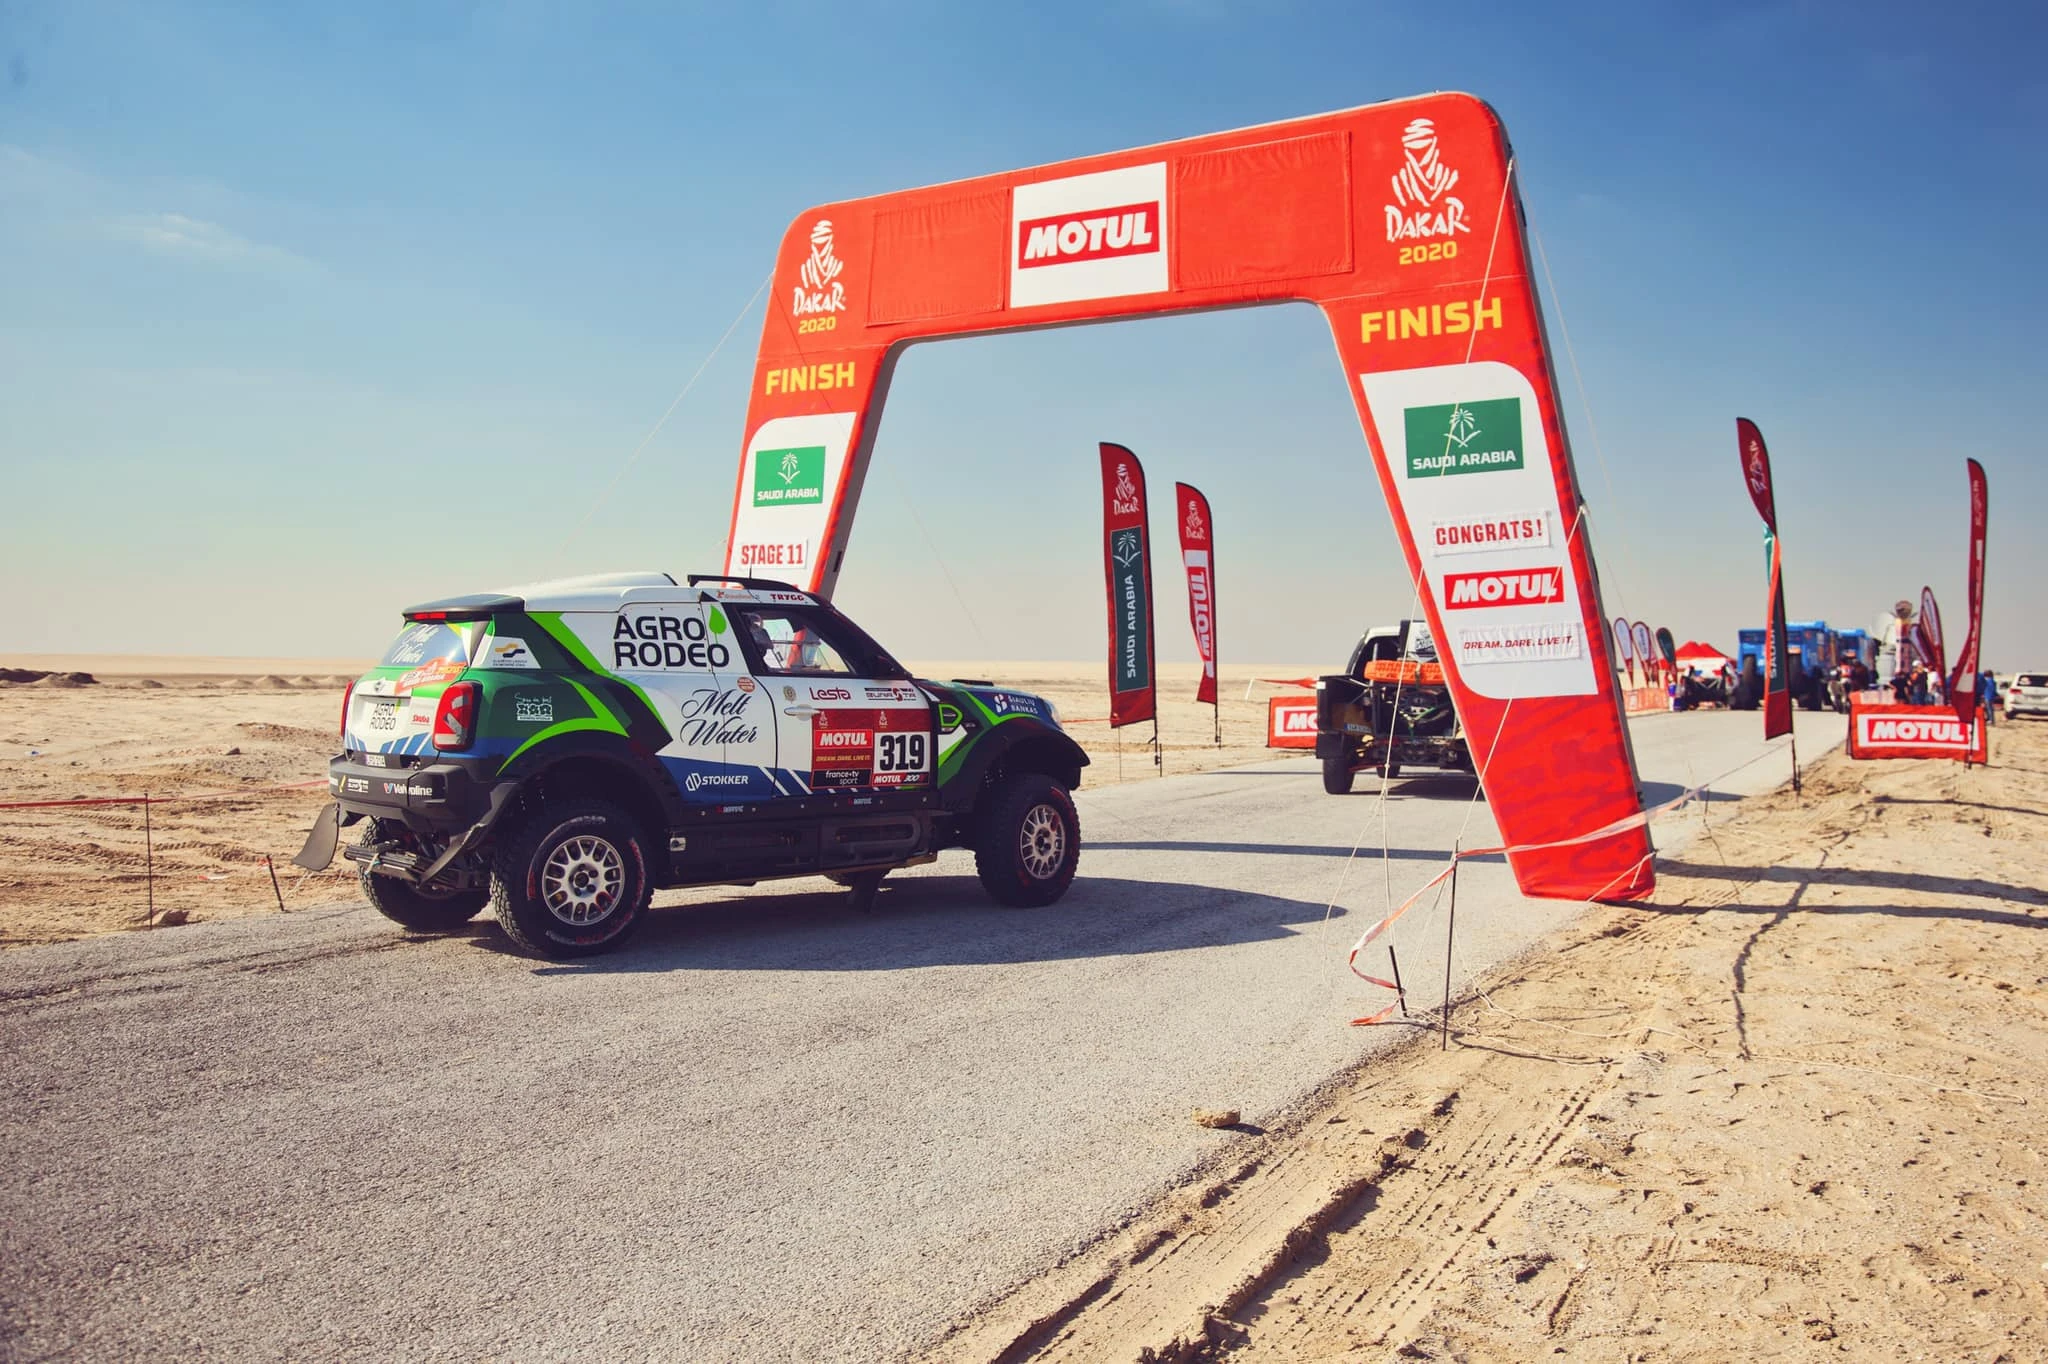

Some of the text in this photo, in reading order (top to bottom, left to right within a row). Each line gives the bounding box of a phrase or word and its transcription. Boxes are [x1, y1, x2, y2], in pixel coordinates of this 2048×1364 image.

[1384, 197, 1471, 242] DAKAR
[1024, 211, 1152, 260] MOTUL
[1399, 241, 1457, 265] 2020
[793, 282, 846, 316] DAKAR
[799, 316, 836, 334] 2020
[1361, 297, 1502, 344] FINISH
[765, 361, 855, 395] FINISH
[1412, 450, 1516, 470] SAUDI ARABIA
[757, 487, 819, 501] SAUDI ARABIA
[1113, 496, 1140, 515] DAKAR
[1435, 519, 1543, 546] CONGRATS!
[741, 543, 803, 565] STAGE 11
[1451, 573, 1558, 604] MOTUL
[1191, 571, 1210, 656] MOTUL
[613, 615, 706, 640] AGRO
[1125, 574, 1137, 679] SAUDI ARABIA
[615, 641, 730, 668] RODEO
[1464, 639, 1503, 650] DREAM.
[1504, 638, 1535, 648] DARE.
[1537, 636, 1562, 646] LIVE
[681, 688, 752, 719] Melt
[809, 687, 851, 700] Lesta
[369, 717, 397, 731] RODEO
[680, 716, 757, 746] Water
[1872, 721, 1965, 742] MOTUL
[820, 732, 867, 746] MOTUL
[879, 735, 925, 771] 319
[394, 783, 433, 796] Valvoline
[701, 774, 748, 785] STOKKER
[839, 778, 858, 786] sport
[874, 775, 901, 783] MOTUL
